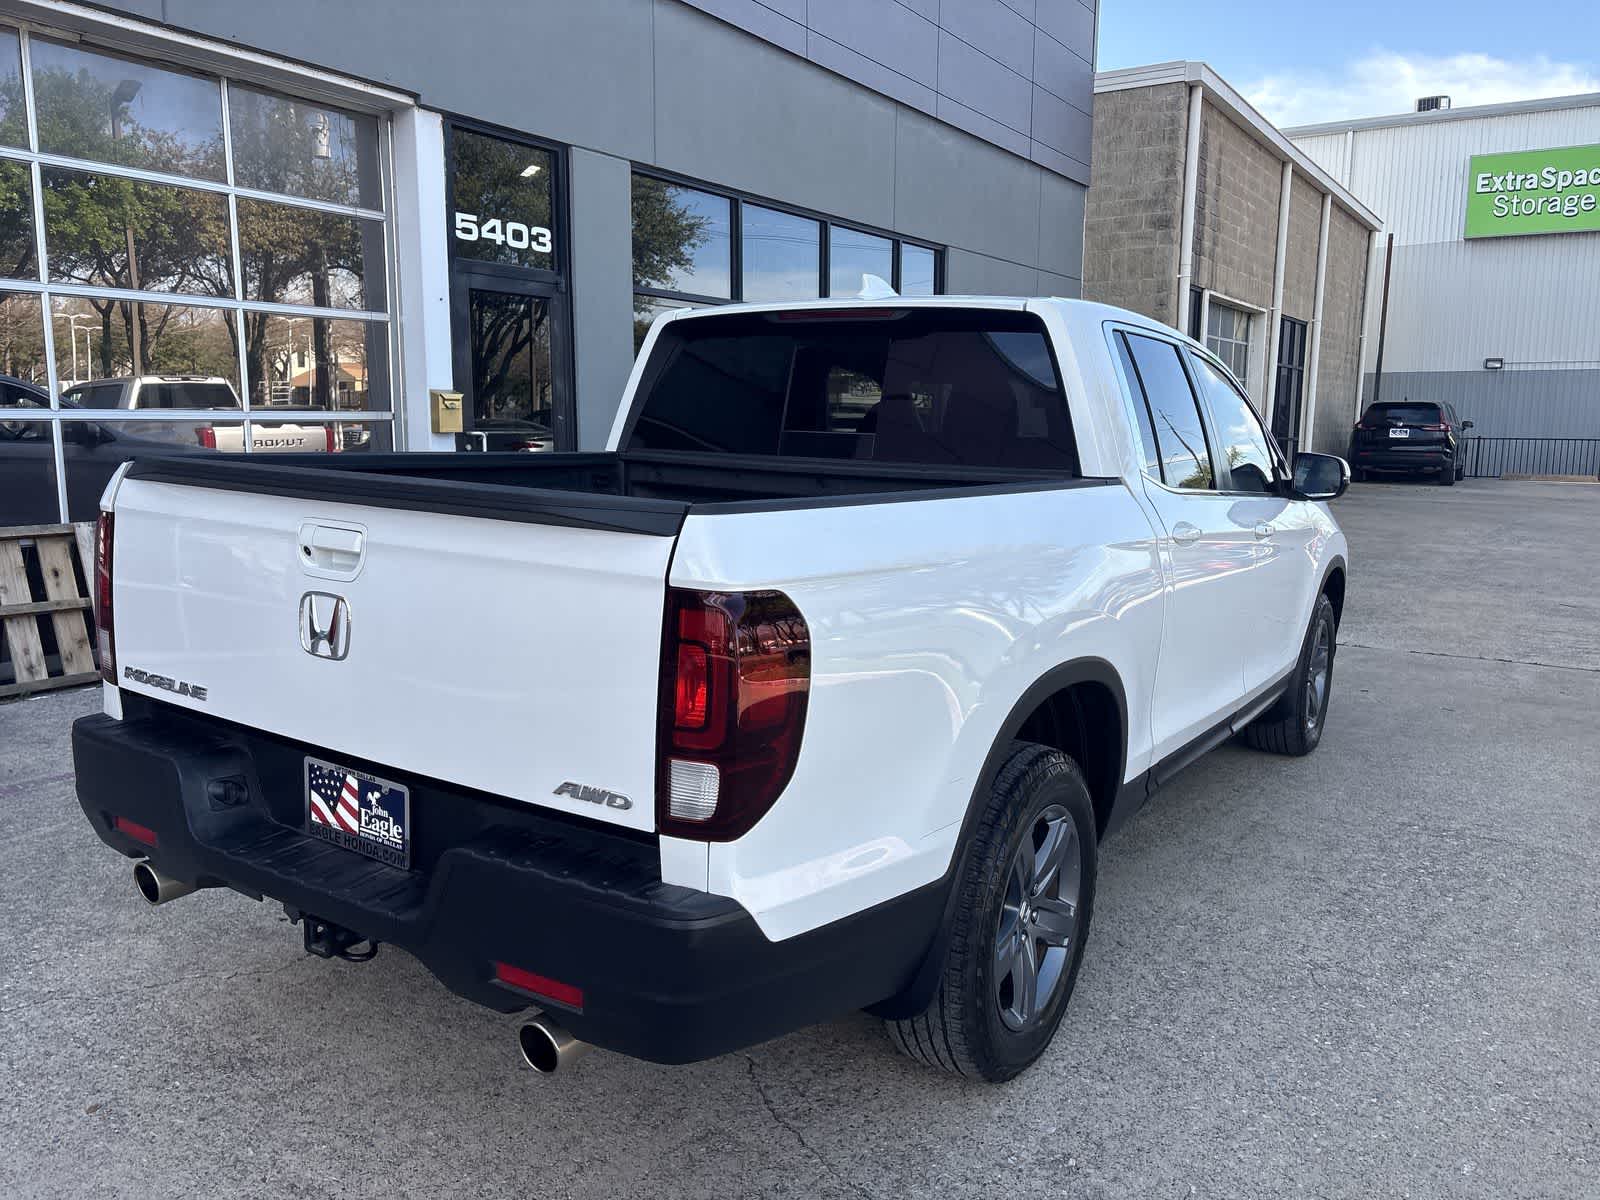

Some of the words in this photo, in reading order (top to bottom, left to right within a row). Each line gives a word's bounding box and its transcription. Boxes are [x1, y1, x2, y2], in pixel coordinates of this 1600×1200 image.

[1493, 194, 1596, 217] Storage
[455, 212, 552, 253] 5403
[124, 666, 208, 701] RIDGELINE
[370, 804, 389, 818] John
[552, 781, 634, 811] AWD
[360, 807, 403, 839] Eagle
